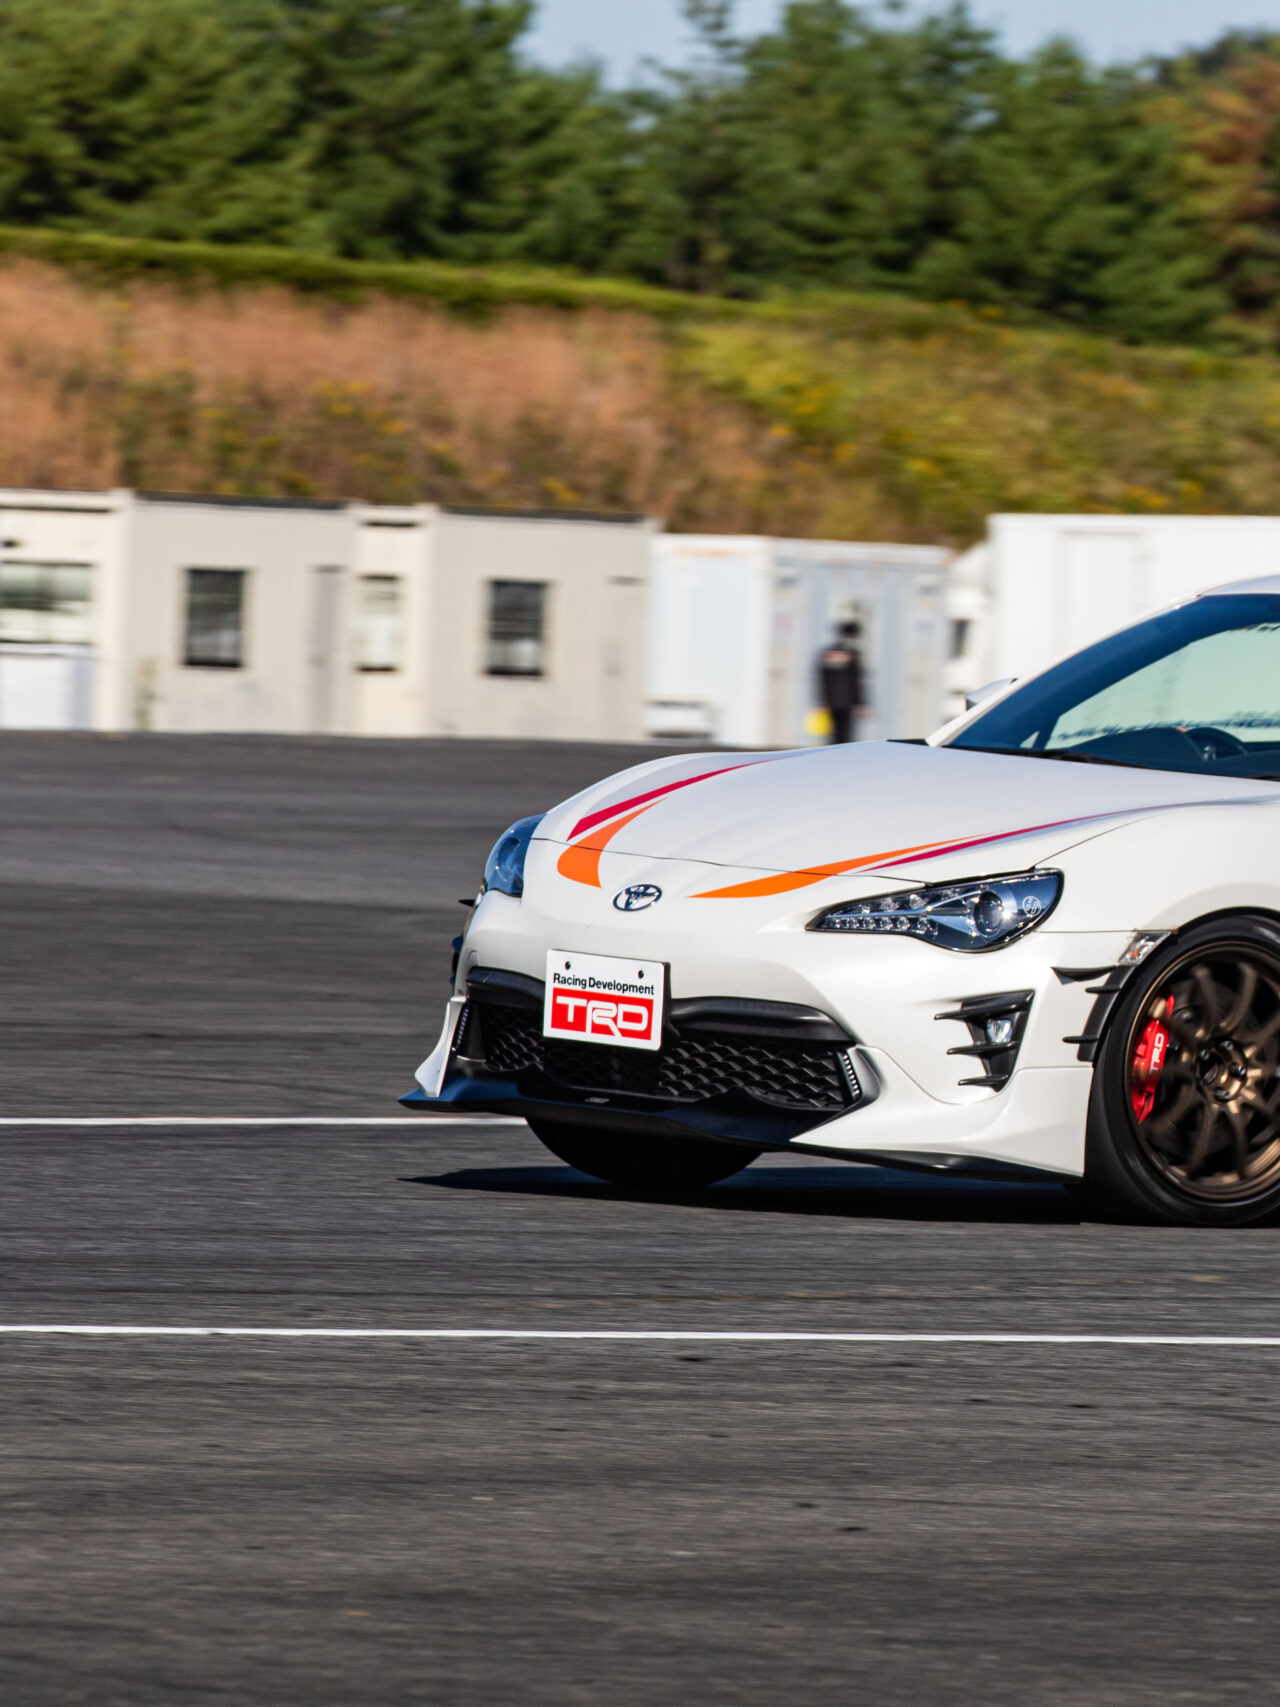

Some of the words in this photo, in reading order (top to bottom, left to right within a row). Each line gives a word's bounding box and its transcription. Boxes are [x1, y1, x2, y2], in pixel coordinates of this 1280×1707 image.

[553, 973, 587, 989] Racing
[588, 977, 655, 995] Development
[556, 995, 649, 1037] TRD
